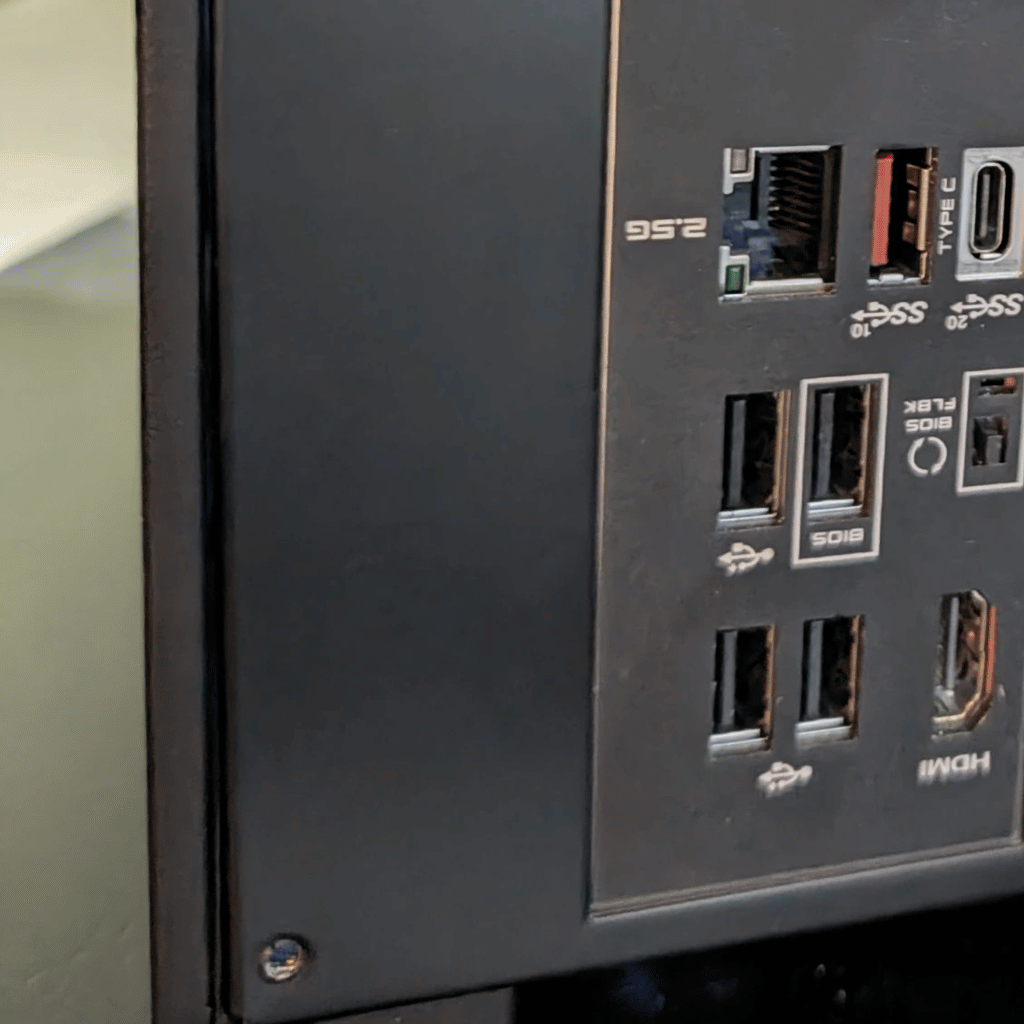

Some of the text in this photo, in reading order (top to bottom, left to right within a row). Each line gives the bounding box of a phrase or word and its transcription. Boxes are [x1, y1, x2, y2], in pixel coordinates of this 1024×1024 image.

[936, 176, 957, 256] TYPE C
[624, 216, 708, 242] 2.5G
[850, 323, 872, 339] 10
[944, 315, 970, 331] 20
[903, 396, 958, 414] FLBK
[905, 415, 954, 433] BIOS
[810, 527, 866, 547] BIOS
[918, 750, 991, 783] HDMI
